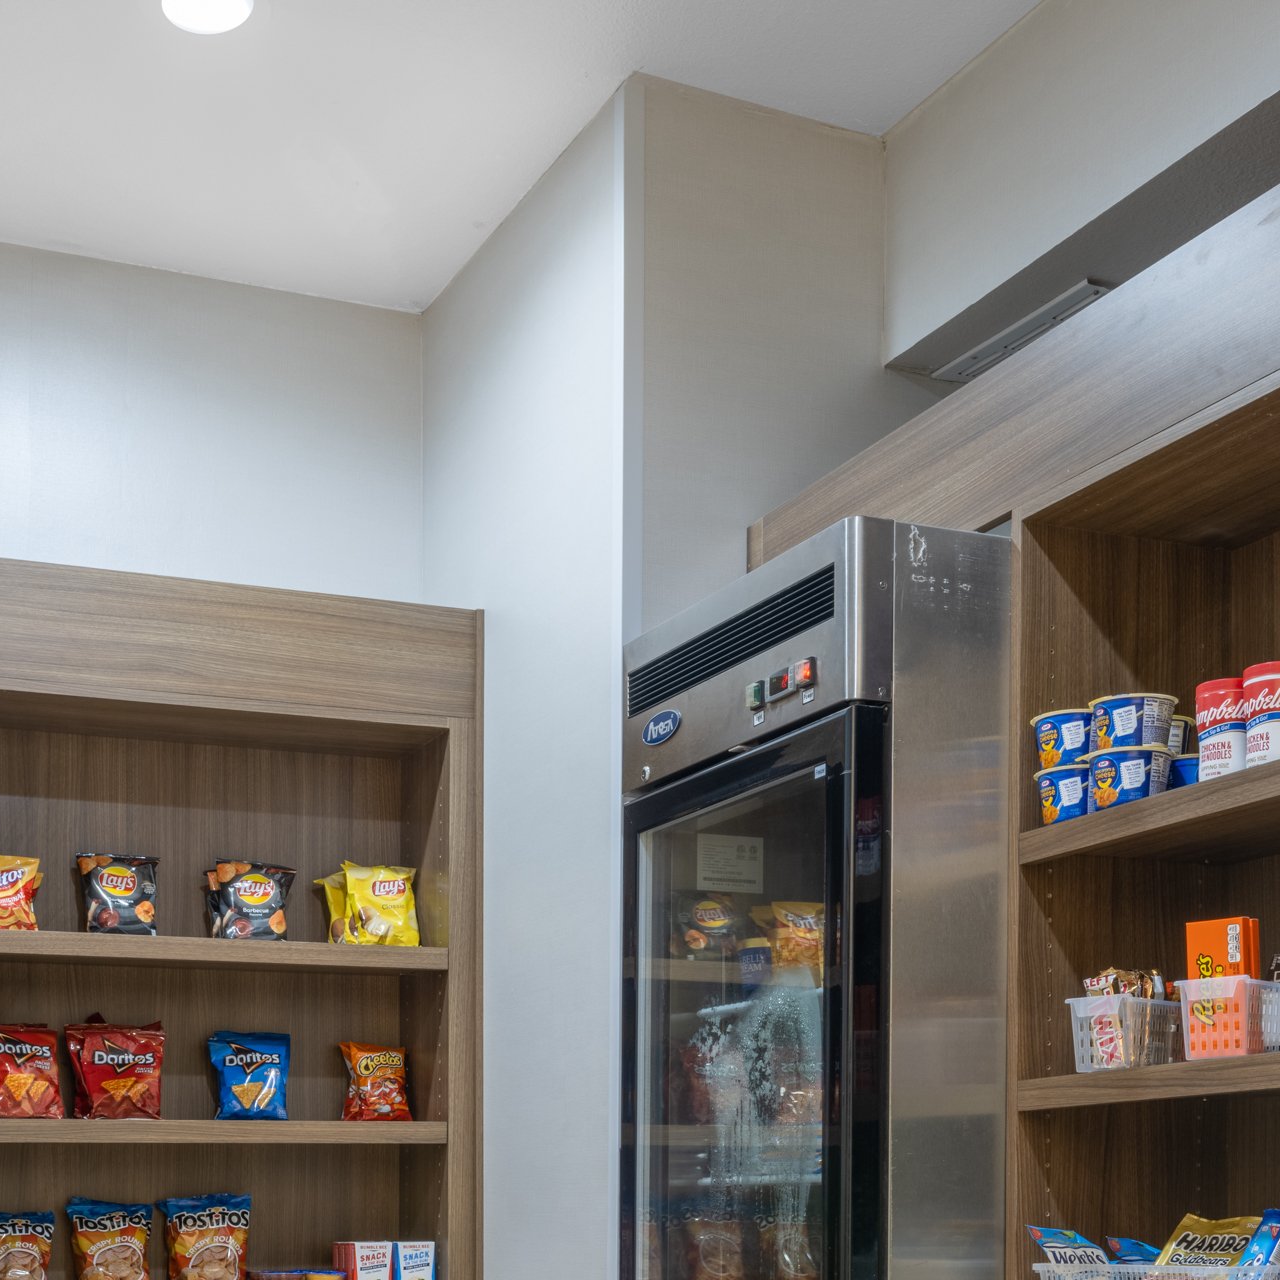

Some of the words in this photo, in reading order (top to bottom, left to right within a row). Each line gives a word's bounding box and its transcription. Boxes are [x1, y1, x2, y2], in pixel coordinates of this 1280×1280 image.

[1265, 732, 1270, 740] &
[1201, 741, 1226, 752] CHICKEN
[1227, 741, 1232, 749] &
[1206, 750, 1232, 761] NOODLES
[101, 873, 136, 890] Lay's
[238, 880, 274, 898] Lay's
[374, 879, 406, 896] Lay's
[1084, 975, 1110, 988] LEFT
[94, 1051, 154, 1065] Doritos
[225, 1053, 279, 1066] Doritos
[358, 1051, 403, 1076] Cheetos
[174, 1208, 249, 1231] TOSTITOS
[185, 1238, 210, 1258] CRISPY
[1178, 1231, 1251, 1254] HARIBO
[360, 1252, 387, 1262] SNACK
[403, 1251, 430, 1261] SNACK
[1054, 1247, 1106, 1265] Welch's
[1169, 1253, 1229, 1268] Goldbears
